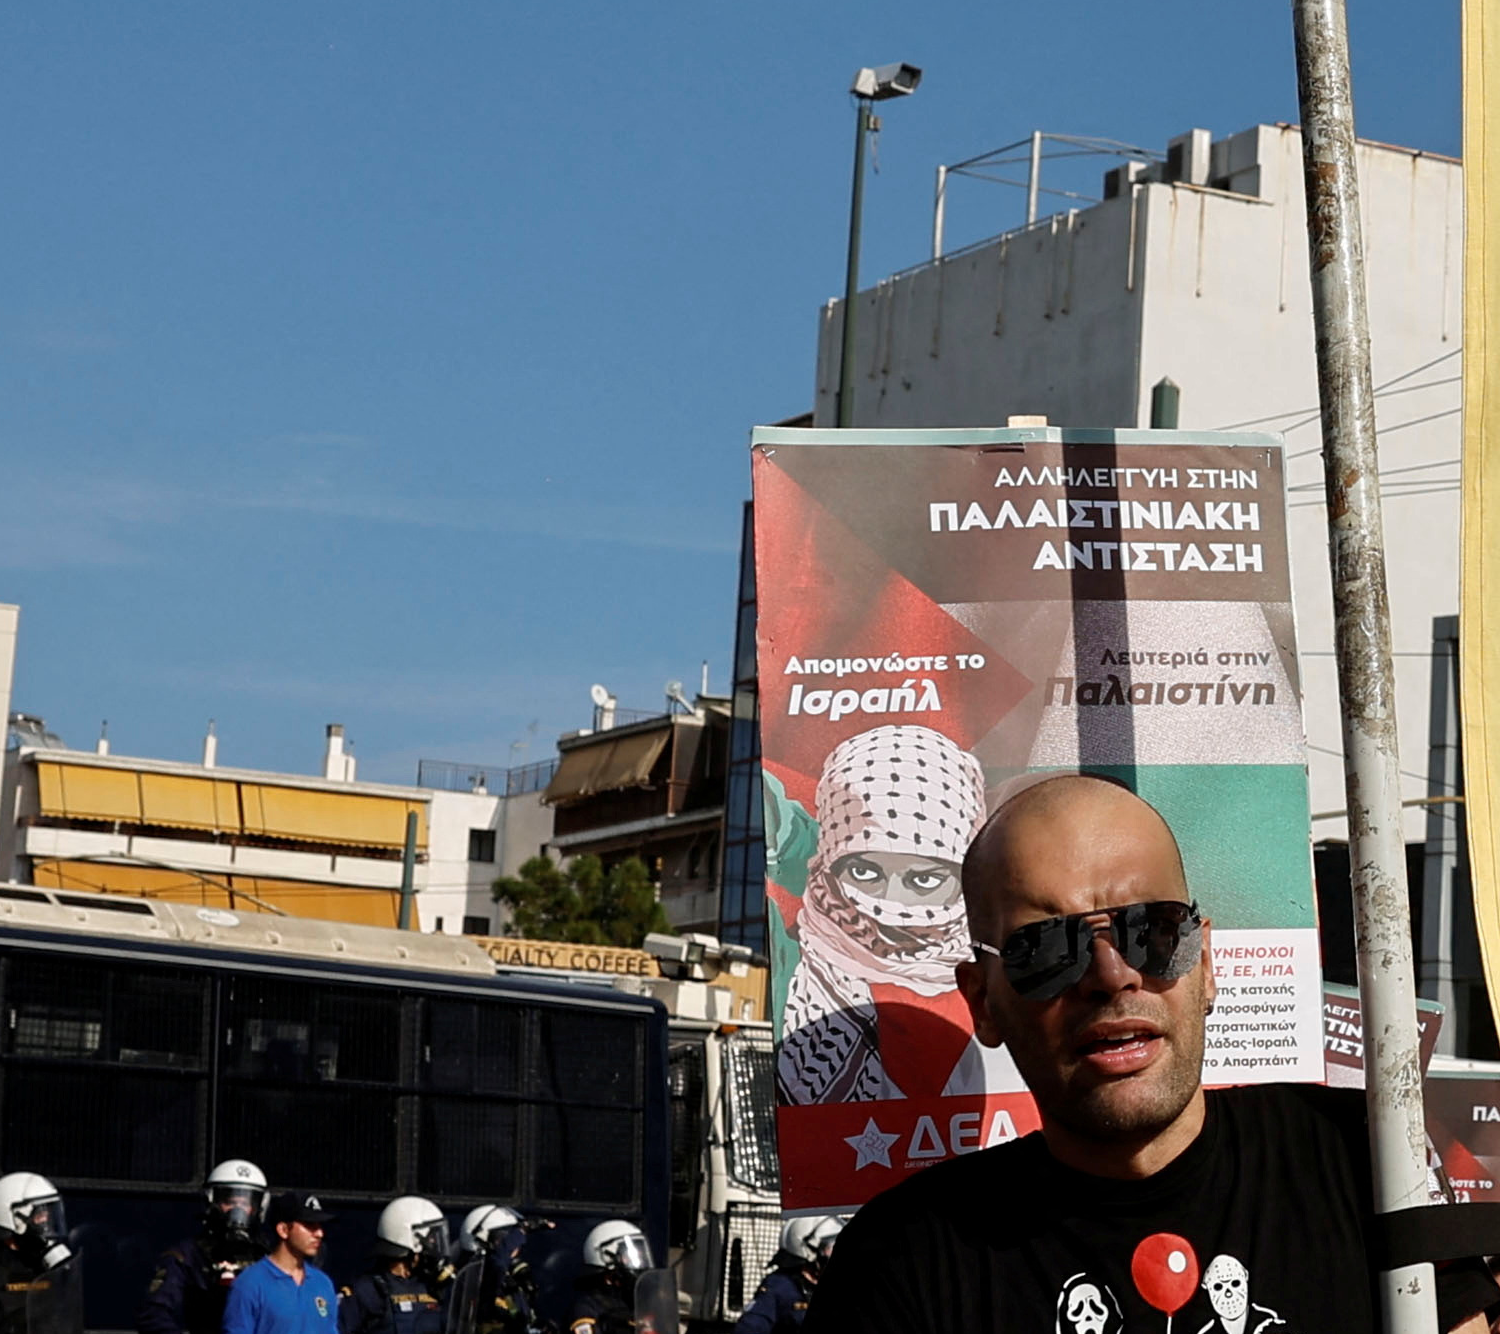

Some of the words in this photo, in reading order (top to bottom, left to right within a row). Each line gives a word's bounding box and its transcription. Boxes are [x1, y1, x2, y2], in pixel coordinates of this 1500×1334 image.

[994, 466, 1178, 488] ΑΛΛΗΛΕΓΓΥΗ
[1187, 469, 1258, 489] ΣΤΗΝ
[929, 499, 1260, 532] ΠΑΛΑΙΣΤΙΝΙΑΚΗ
[1032, 541, 1263, 572] ΑΝΤΙΣΤΑΣΗ
[784, 651, 948, 677] Απομονώστε
[955, 653, 985, 670] το
[1100, 648, 1208, 668] Λευτεριά
[1216, 651, 1270, 667] στην
[788, 677, 941, 721] Ισραήλ
[1044, 676, 1276, 706] Παλαιστίνη
[487, 945, 558, 968] CIALTY
[570, 953, 650, 975] COFFEE
[1213, 947, 1294, 958] ΥΝΕΝΟΧΟΙ
[1262, 965, 1294, 976] ΗΠΑ
[1241, 983, 1295, 996] κατοχής
[1217, 1002, 1295, 1015] προσφύγων
[1206, 1036, 1297, 1049] λάδας-Ισραήλ
[1223, 1055, 1298, 1068] Απαρτχάιντ
[907, 1110, 1019, 1158] ΔΕΑ
